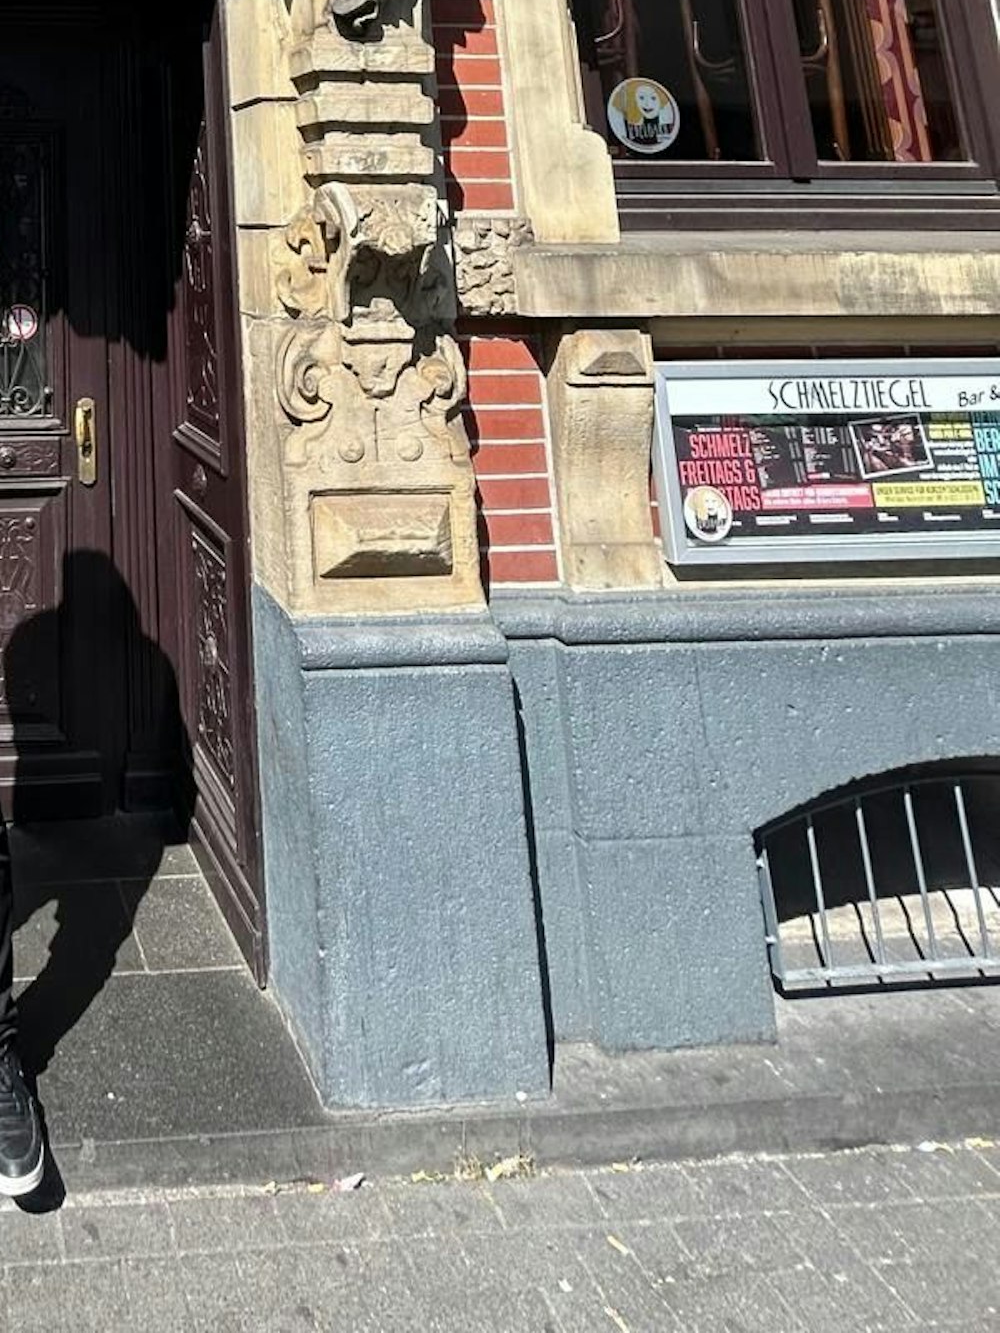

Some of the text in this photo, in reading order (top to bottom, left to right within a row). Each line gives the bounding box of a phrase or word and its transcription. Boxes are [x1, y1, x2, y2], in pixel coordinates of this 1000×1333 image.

[769, 379, 932, 409] SCHMELZTIEGEL
[958, 390, 985, 407] Bar
[689, 433, 752, 459] SCHMELZ
[679, 460, 742, 486] FREITAGS
